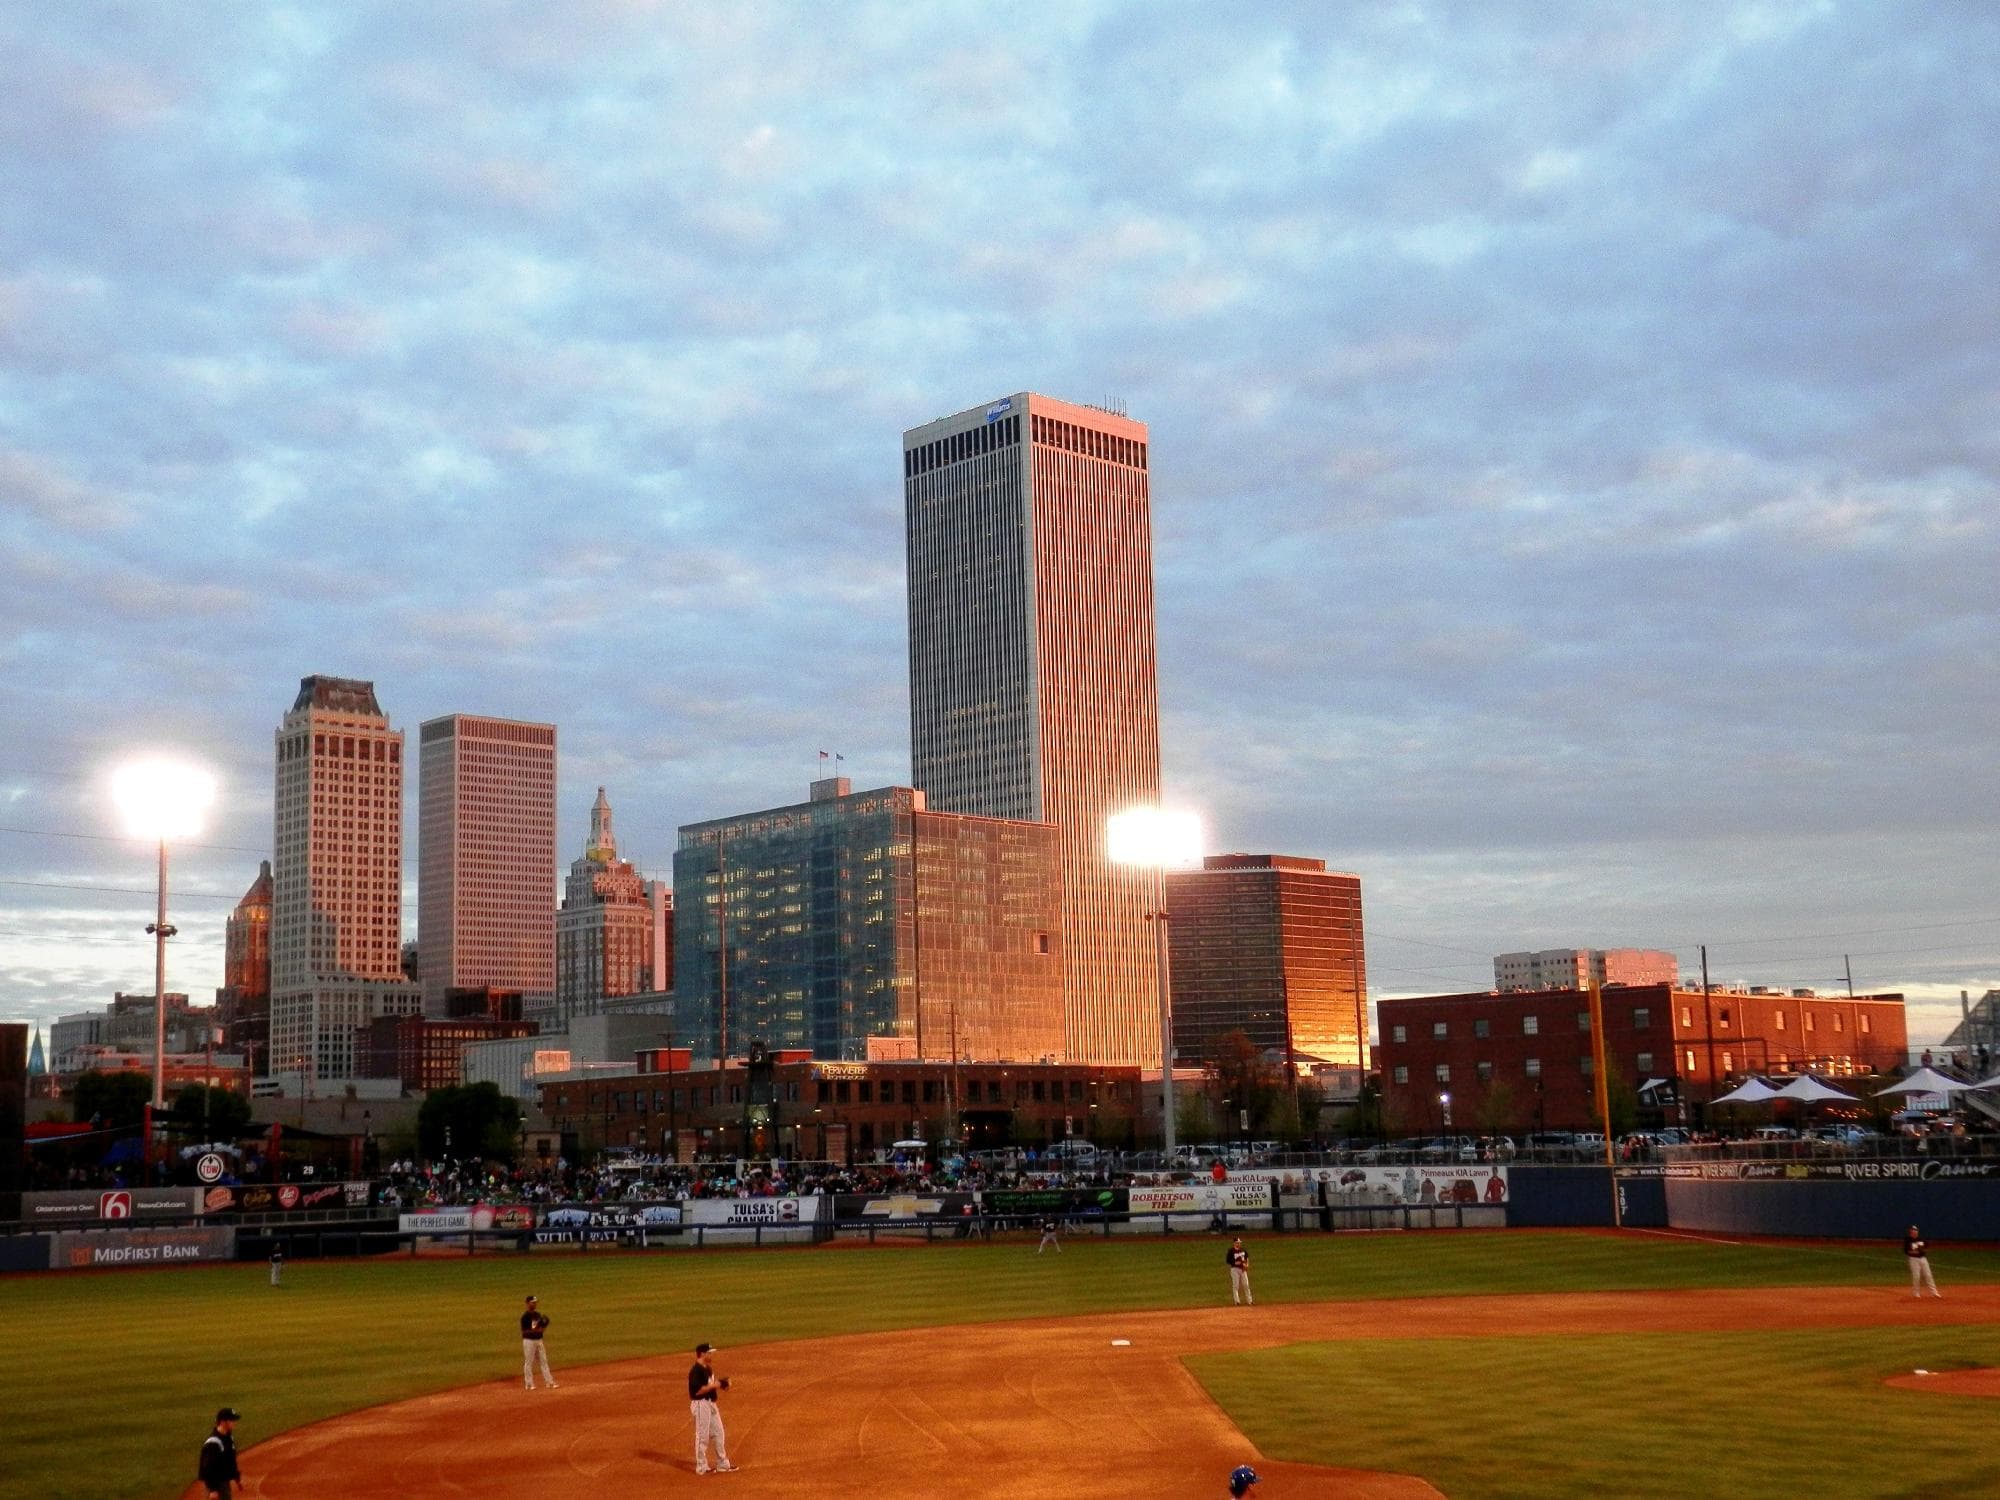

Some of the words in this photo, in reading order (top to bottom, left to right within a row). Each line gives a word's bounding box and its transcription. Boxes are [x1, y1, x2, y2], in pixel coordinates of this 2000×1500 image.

[822, 1064, 867, 1075] PERIMETER
[1420, 1168, 1454, 1177] Primeaux
[1455, 1168, 1468, 1177] KIA
[1469, 1168, 1489, 1177] Lawn
[1844, 1163, 1881, 1181] RIVER
[1882, 1163, 1920, 1177] SPIRIT
[1921, 1159, 1998, 1181] Casino
[1132, 1192, 1195, 1202] ROBERTSON
[1230, 1192, 1267, 1200] TULSA'S
[105, 1192, 126, 1218] 6
[1151, 1200, 1176, 1209] TIRE
[1236, 1199, 1263, 1207] BEST!
[733, 1203, 775, 1215] TULSA's
[407, 1217, 420, 1228] THE
[420, 1216, 447, 1228] PERFECT
[448, 1215, 467, 1227] GAME
[163, 1245, 200, 1258] BANK
